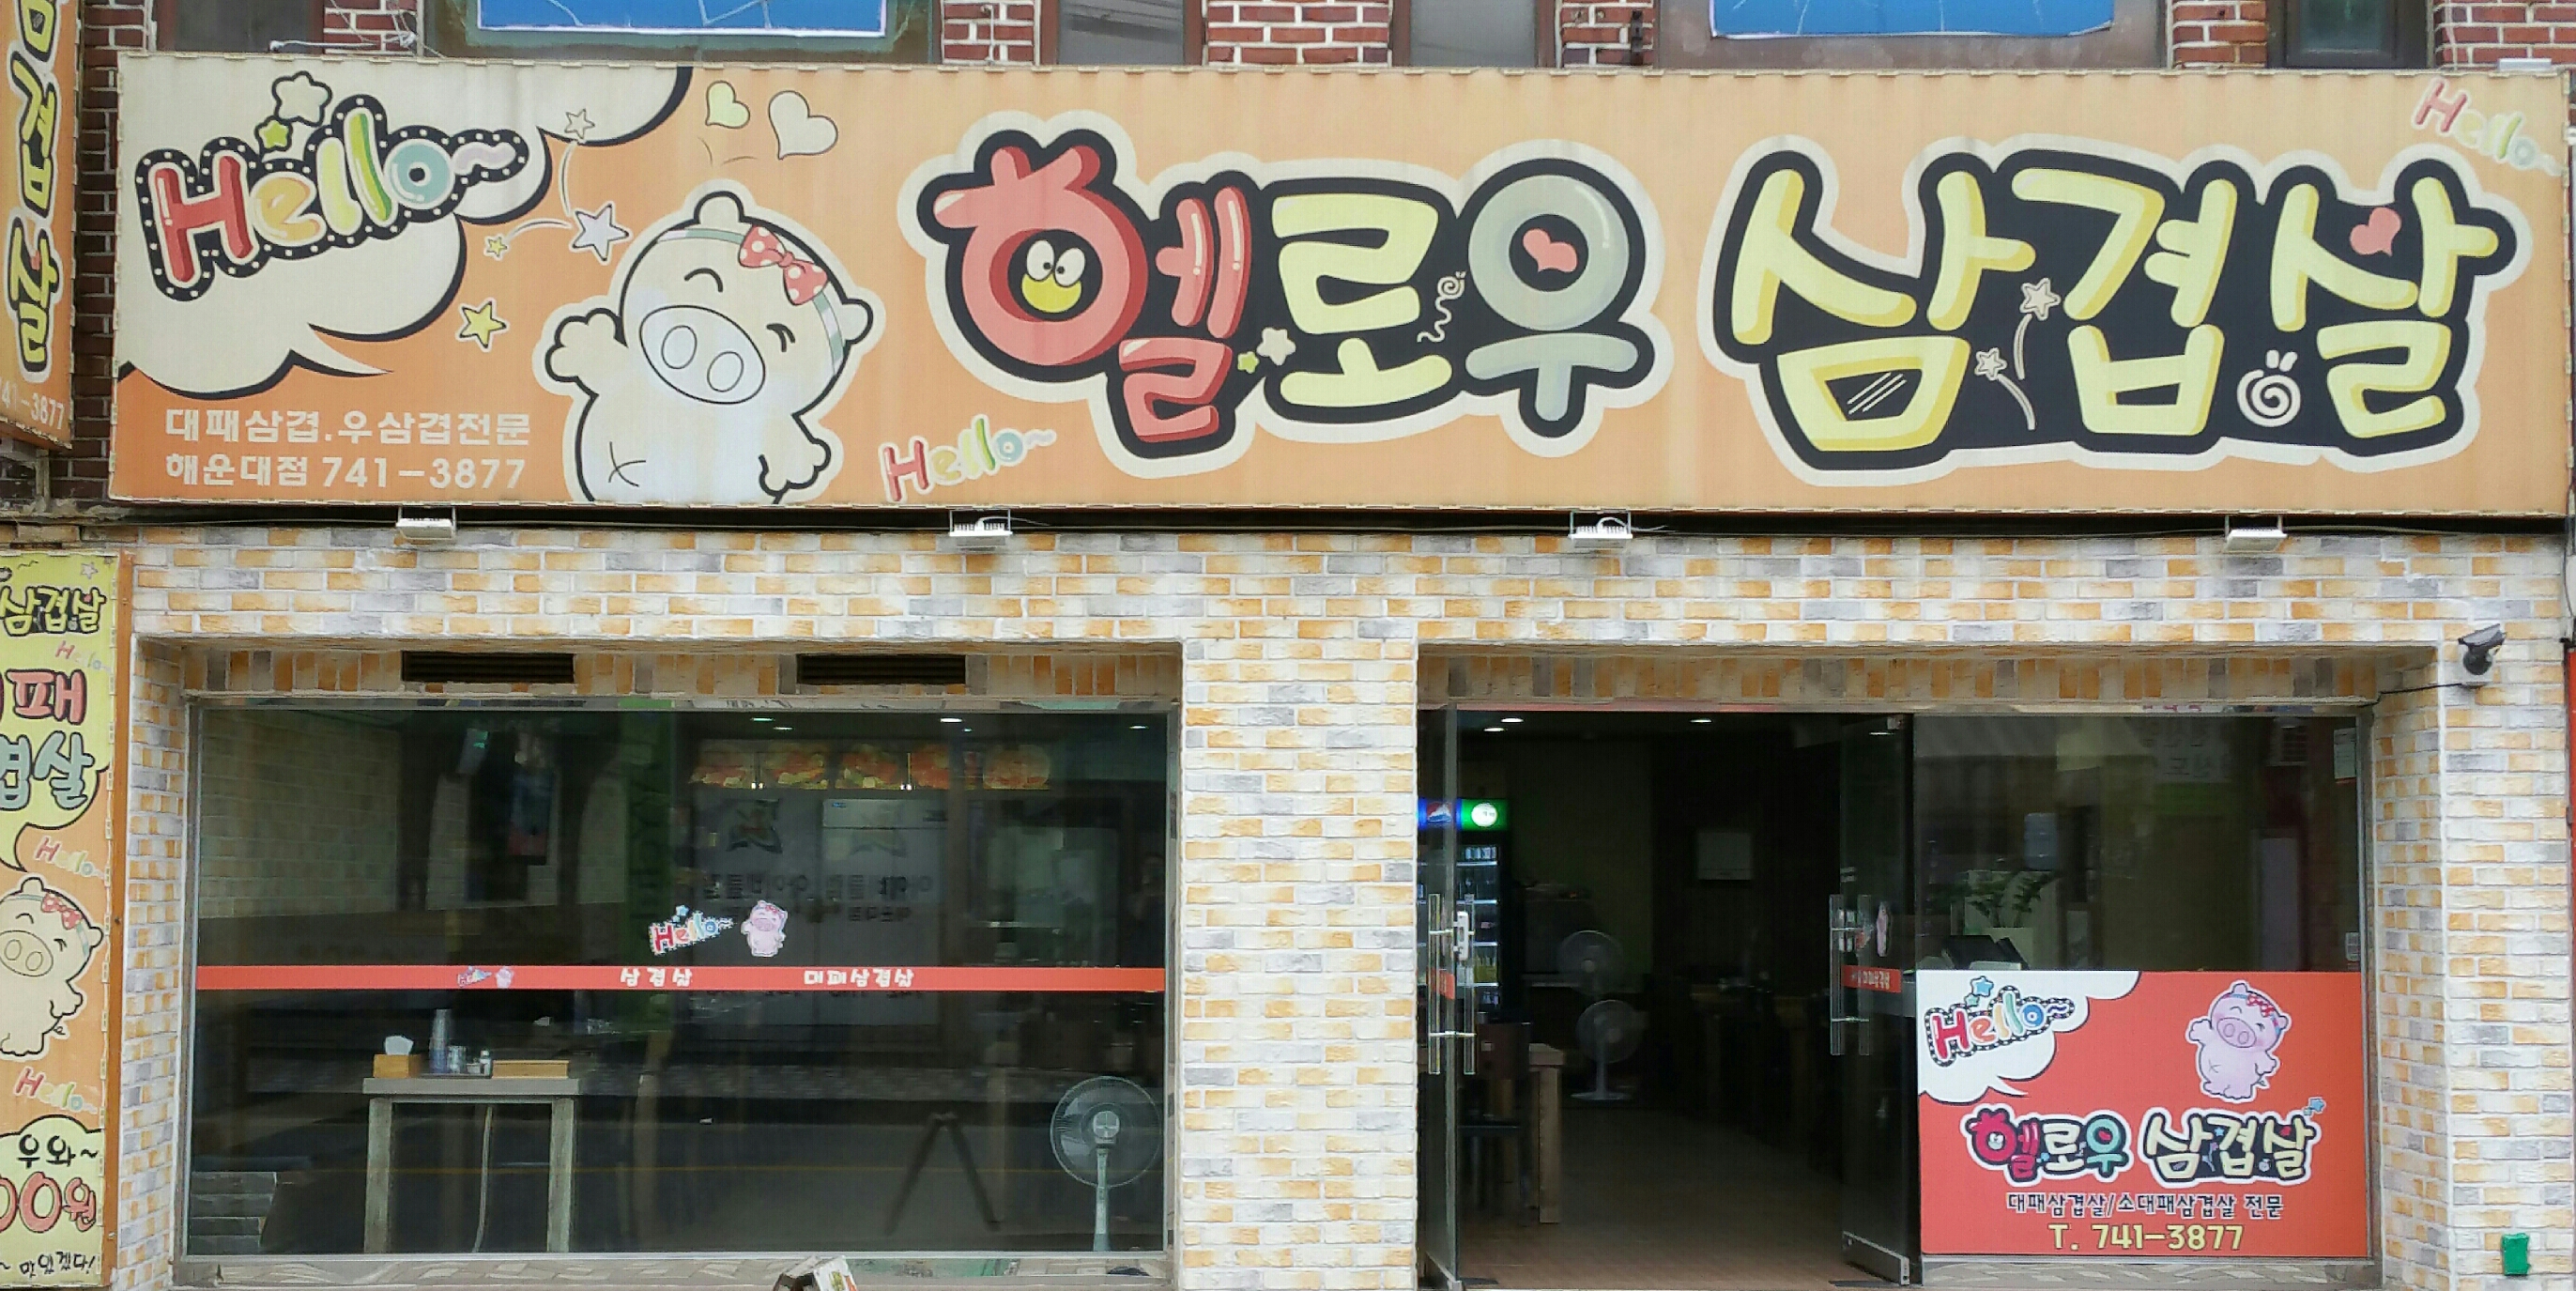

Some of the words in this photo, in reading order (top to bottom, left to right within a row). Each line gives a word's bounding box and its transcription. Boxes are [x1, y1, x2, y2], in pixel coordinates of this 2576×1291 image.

[916, 128, 1656, 459] 헬로우
[1712, 148, 2519, 471] 삼겹살
[0, 379, 64, 429] 41-3877
[165, 453, 308, 486] 해운대점
[321, 456, 526, 488] 741-3877
[0, 585, 107, 637] 삼겹살
[1967, 1108, 2130, 1181] 헬로우
[2144, 1111, 2317, 1181] 삼겹살
[2244, 1193, 2284, 1219] 전문
[2047, 1223, 2080, 1251] T.
[2091, 1223, 2244, 1251] 741-3877
